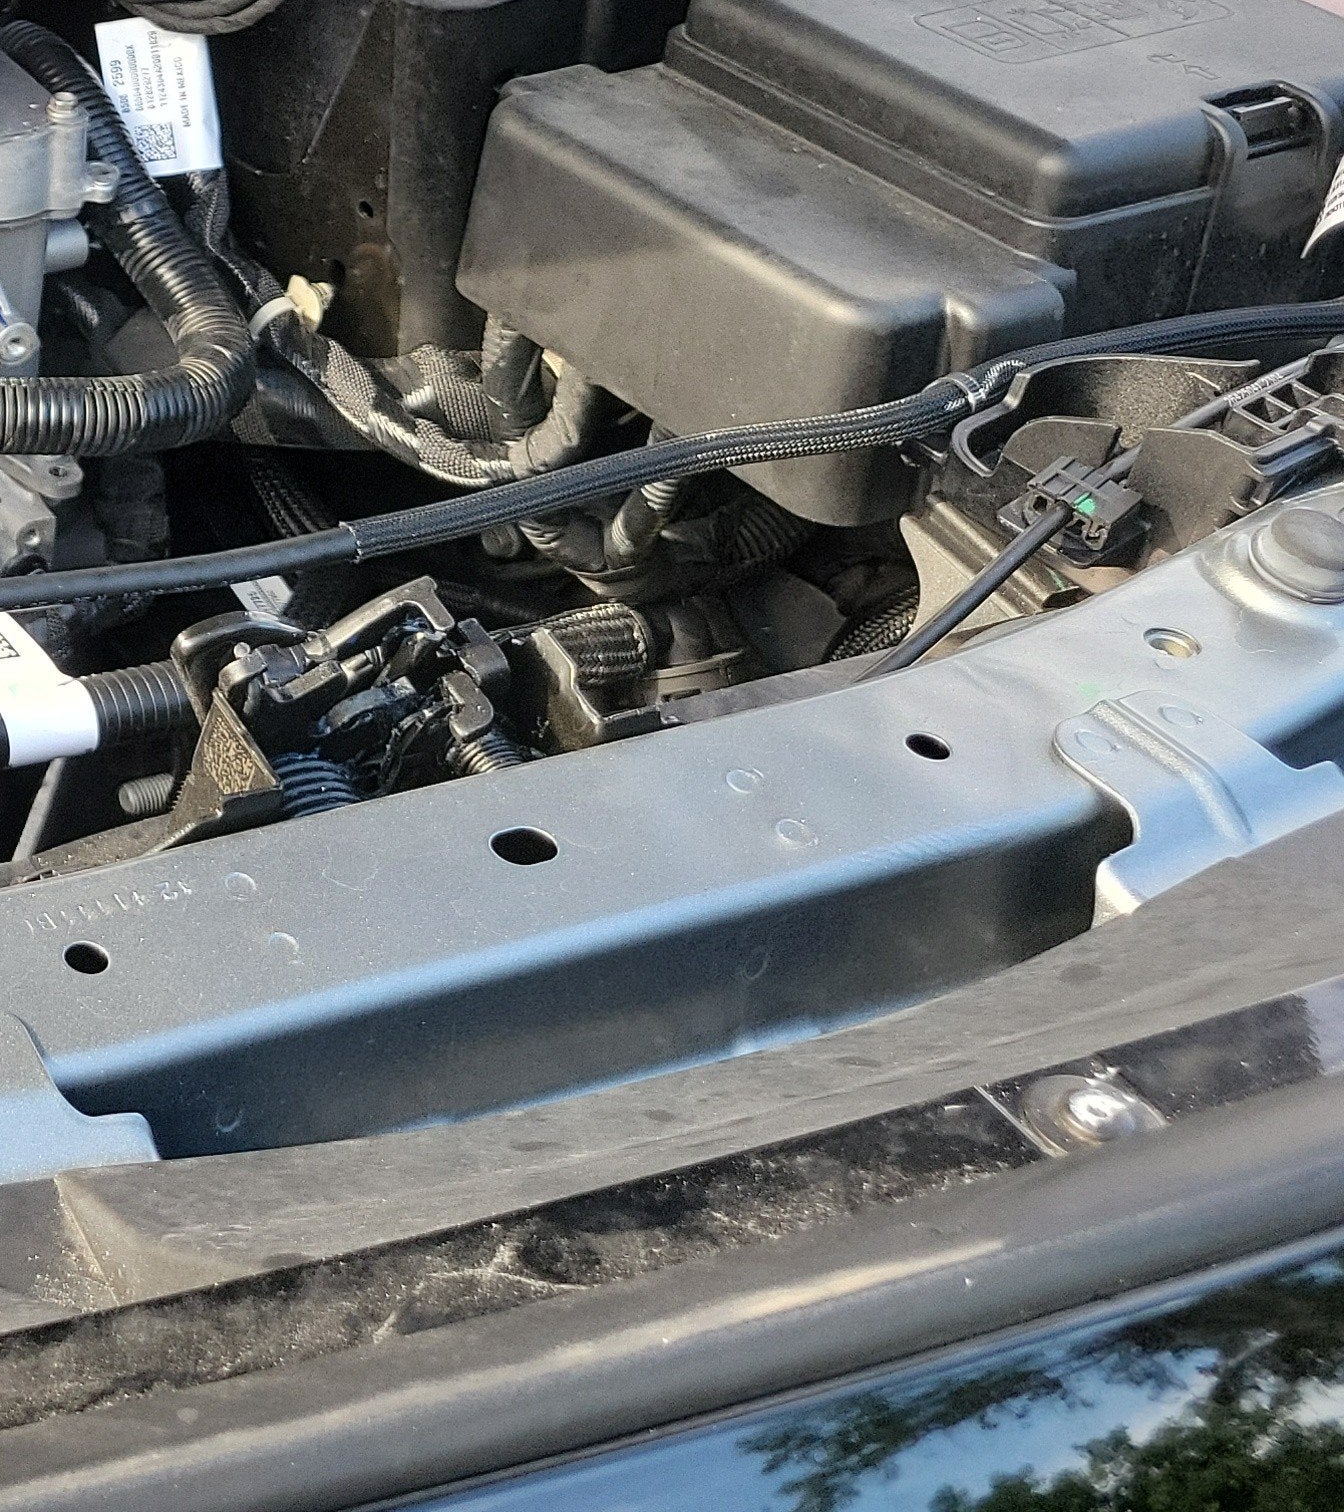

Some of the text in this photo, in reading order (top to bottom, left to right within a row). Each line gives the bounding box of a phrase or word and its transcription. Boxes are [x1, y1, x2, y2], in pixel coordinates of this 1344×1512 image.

[109, 59, 125, 87] 2599
[173, 56, 187, 89] MEXICO
[179, 91, 188, 101] IN
